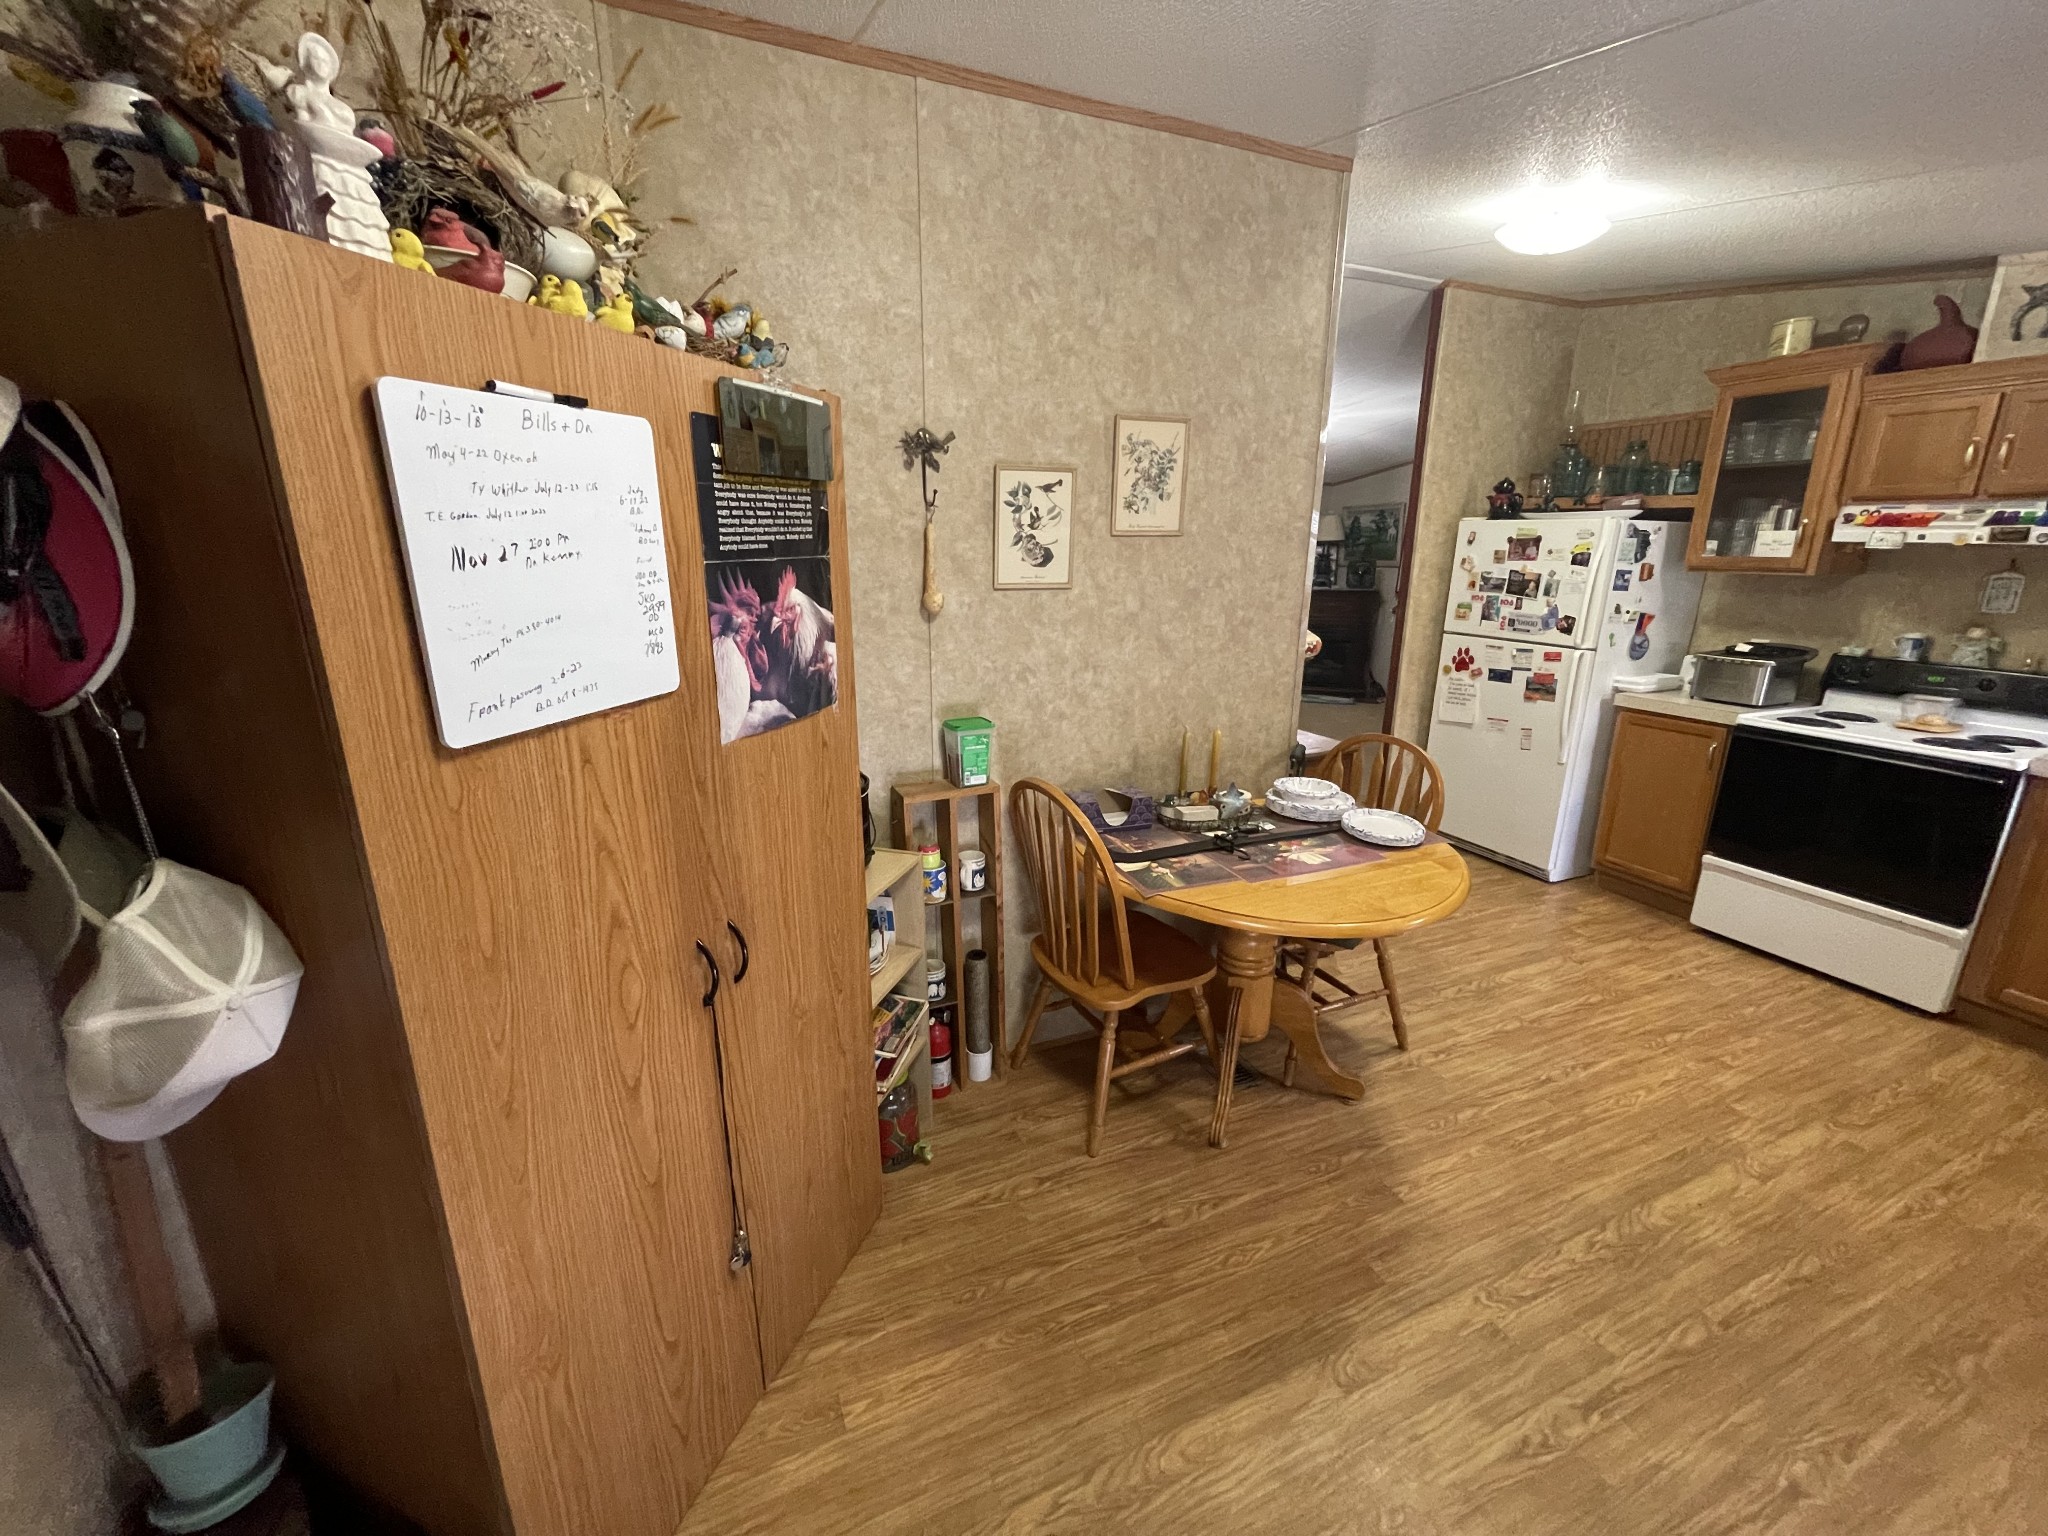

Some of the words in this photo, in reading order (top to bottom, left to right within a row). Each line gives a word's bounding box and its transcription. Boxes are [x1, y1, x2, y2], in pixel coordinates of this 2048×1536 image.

[521, 408, 557, 433] Bills
[426, 442, 456, 464] May
[451, 544, 488, 573] Nov
